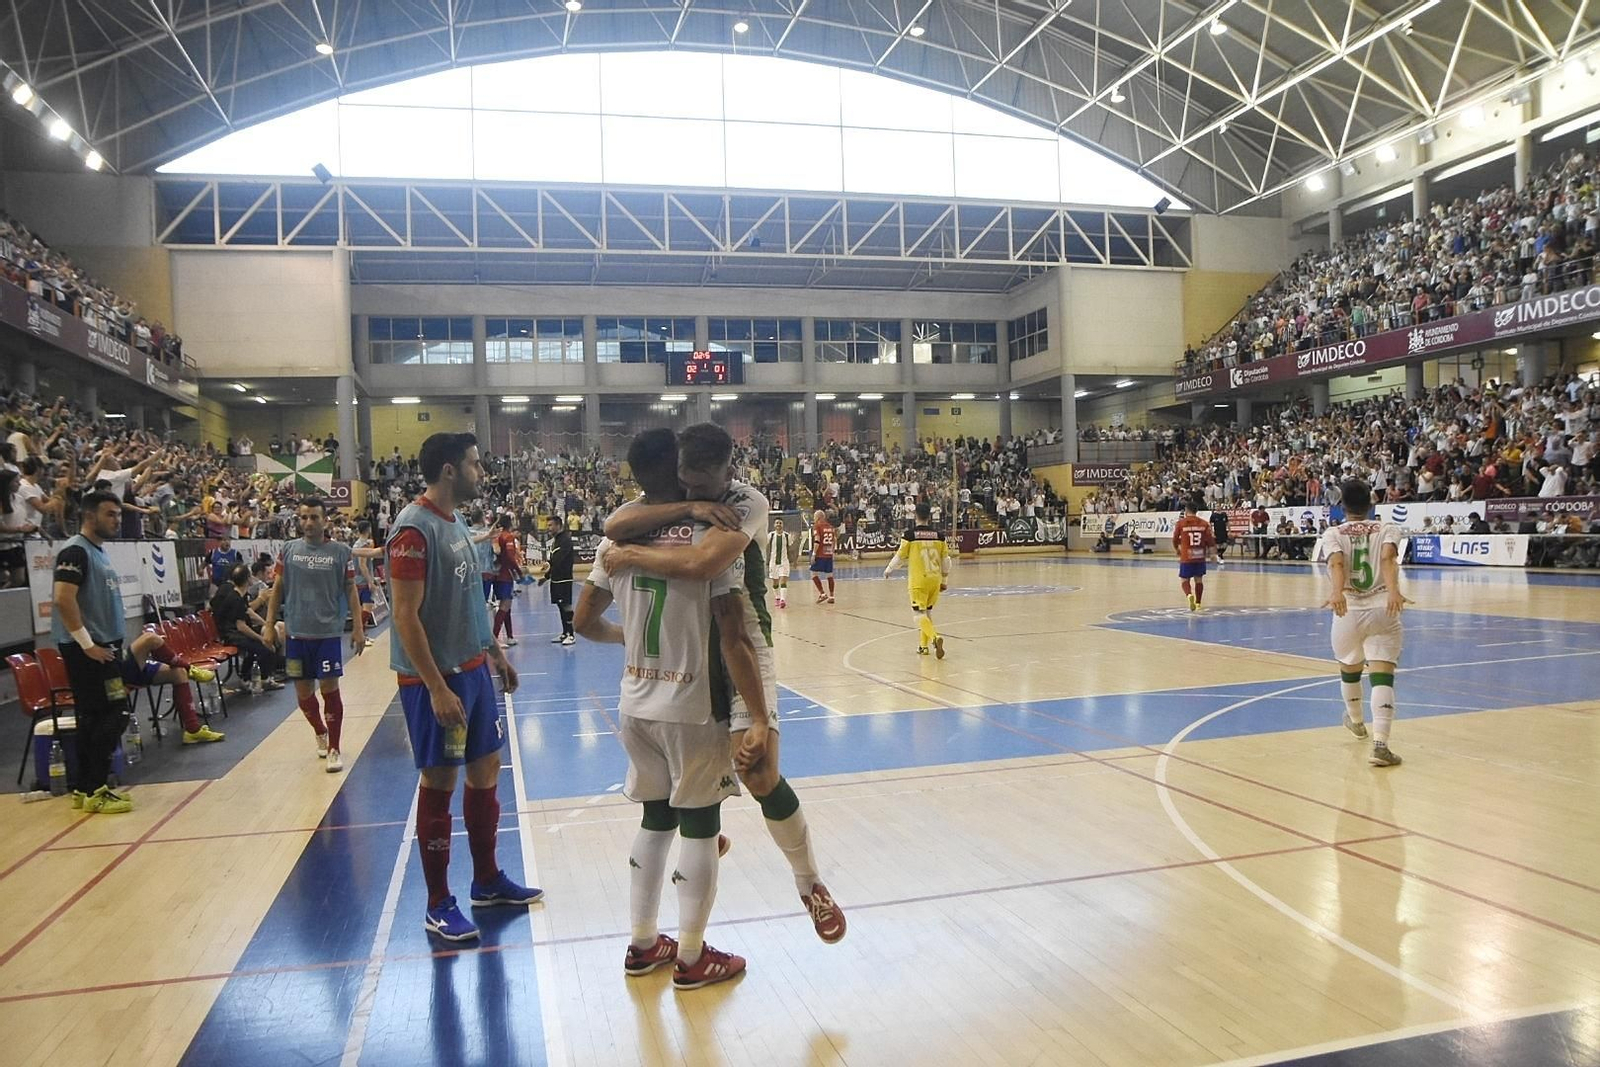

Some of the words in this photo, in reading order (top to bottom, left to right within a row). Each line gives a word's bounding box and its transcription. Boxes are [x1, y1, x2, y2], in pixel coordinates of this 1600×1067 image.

[1517, 286, 1600, 323] IMDECO
[98, 335, 131, 365] IMDECO
[1311, 340, 1367, 366] IMDECO
[1183, 375, 1213, 392] IMDECO
[1086, 468, 1128, 479] IMDECO
[822, 532, 834, 545] 22
[1188, 532, 1202, 546] 13
[1350, 548, 1374, 591] 5
[632, 576, 667, 658] 7
[322, 660, 331, 673] 5
